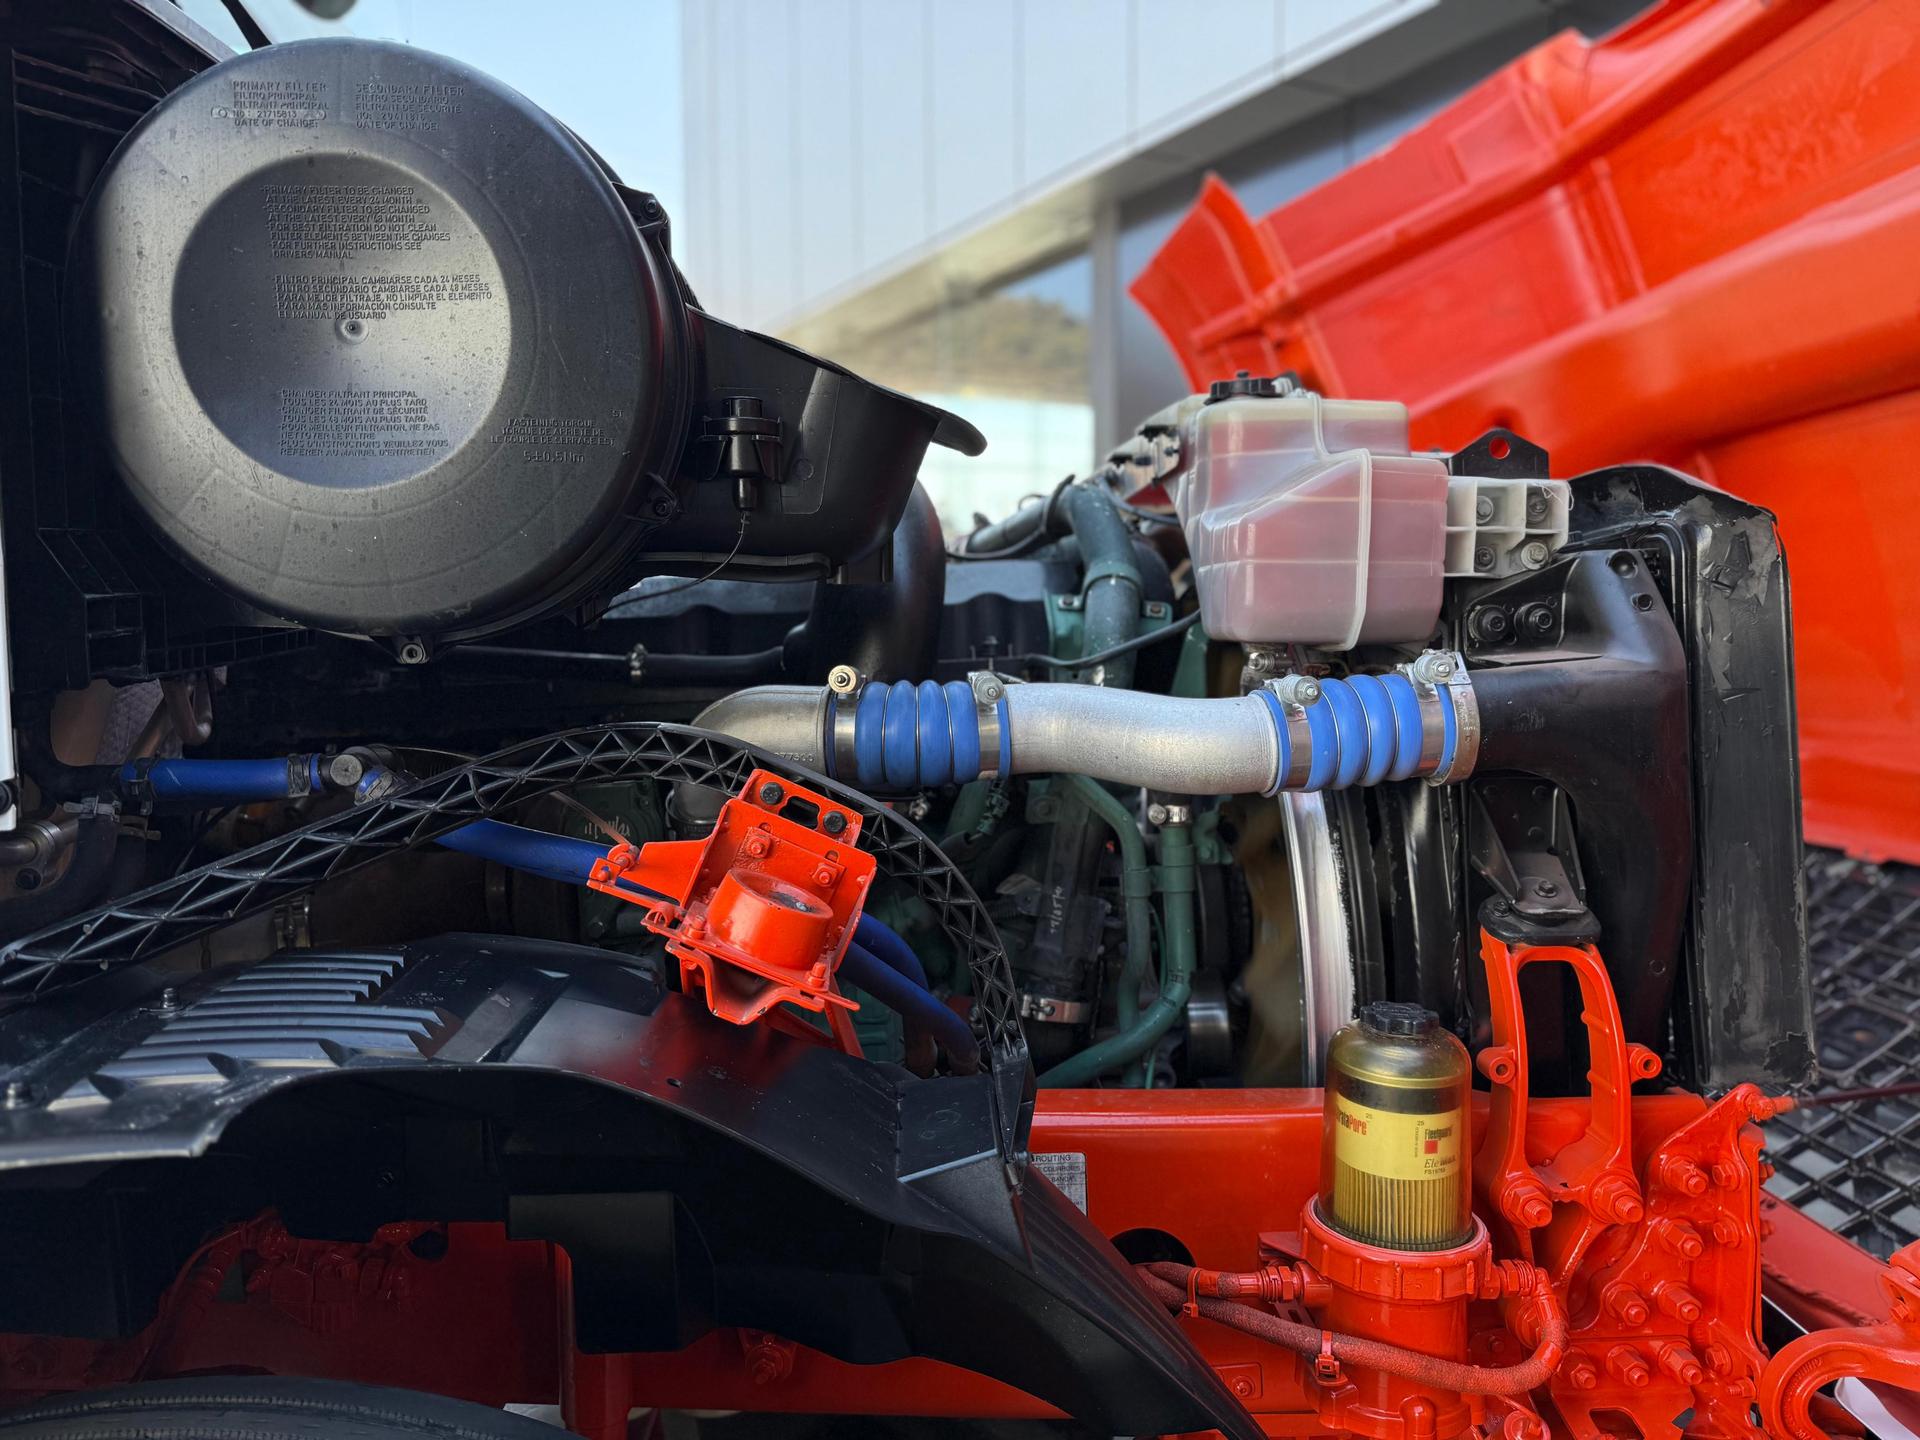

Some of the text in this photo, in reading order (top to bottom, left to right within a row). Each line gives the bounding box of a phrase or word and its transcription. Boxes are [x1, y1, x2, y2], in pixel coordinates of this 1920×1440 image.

[233, 80, 328, 92] PRIMARY FILTER
[257, 110, 297, 119] 21715813
[234, 119, 258, 127] DATE
[262, 119, 273, 127] OF
[309, 186, 342, 195] FILTER
[343, 186, 356, 195] TO
[358, 186, 369, 195] BE
[372, 186, 415, 195] CHANGED
[266, 194, 412, 204] AT THE LATEST EVERY 24 MONTH
[327, 204, 359, 213] FILTER
[361, 204, 373, 214] TO
[375, 204, 387, 214] BE
[389, 205, 431, 214] CHANGED
[268, 213, 281, 222] AT
[284, 213, 302, 222] THE
[304, 213, 339, 223] LATEST
[341, 213, 371, 223] EVERY
[385, 214, 415, 223] MONTH
[292, 223, 316, 232] BEST
[318, 222, 372, 232] FILTRATION
[374, 223, 387, 232] DO
[388, 223, 405, 232] NOT
[407, 223, 437, 232] CLEAN
[271, 231, 451, 241] FILTER ELEMENTS BETWEEN THE CHANGES
[294, 241, 337, 250] FURTHER
[338, 241, 403, 250] INSTRUCTIONS
[404, 241, 422, 250] SEE
[272, 250, 353, 259] DRIVERS MANUAL
[311, 275, 359, 284] PRINCIPAL
[361, 275, 412, 284] CAMBIARSE
[414, 275, 438, 284] CADA
[440, 275, 450, 283] 24
[452, 274, 481, 283] MESES
[311, 284, 367, 294] SECUNDARIO
[371, 284, 421, 293] CAMBIARSE
[423, 284, 448, 293] CADA
[450, 283, 459, 292] 48
[461, 283, 490, 292] MESES
[306, 293, 338, 302] MEJOR
[386, 294, 398, 302] NO
[400, 293, 434, 302] LIMPIAR
[436, 293, 446, 301] EL
[448, 292, 492, 301] ELEMENTO
[392, 302, 437, 311] CONSULTE
[278, 311, 386, 320] EL MANUAL DE USUARIO
[328, 390, 371, 398] FILTRANT
[373, 390, 418, 398] PRINCIPAL
[283, 398, 427, 407] TOUS LES 24 MOIS AU PLUS TARD
[328, 407, 371, 415] FILTRANT
[373, 407, 385, 415] DE
[283, 415, 307, 423] TOUS
[309, 415, 327, 423] LES
[341, 416, 363, 424] MOIS
[365, 416, 378, 424] AU
[379, 416, 402, 424] PLUS
[404, 415, 426, 424] TARD
[309, 423, 353, 432] MEILLEUR
[409, 424, 421, 432] NE
[423, 423, 440, 432] PAS
[1424, 1125, 1454, 1141] Fleetguard
[1035, 1154, 1071, 1162] ROUTING
